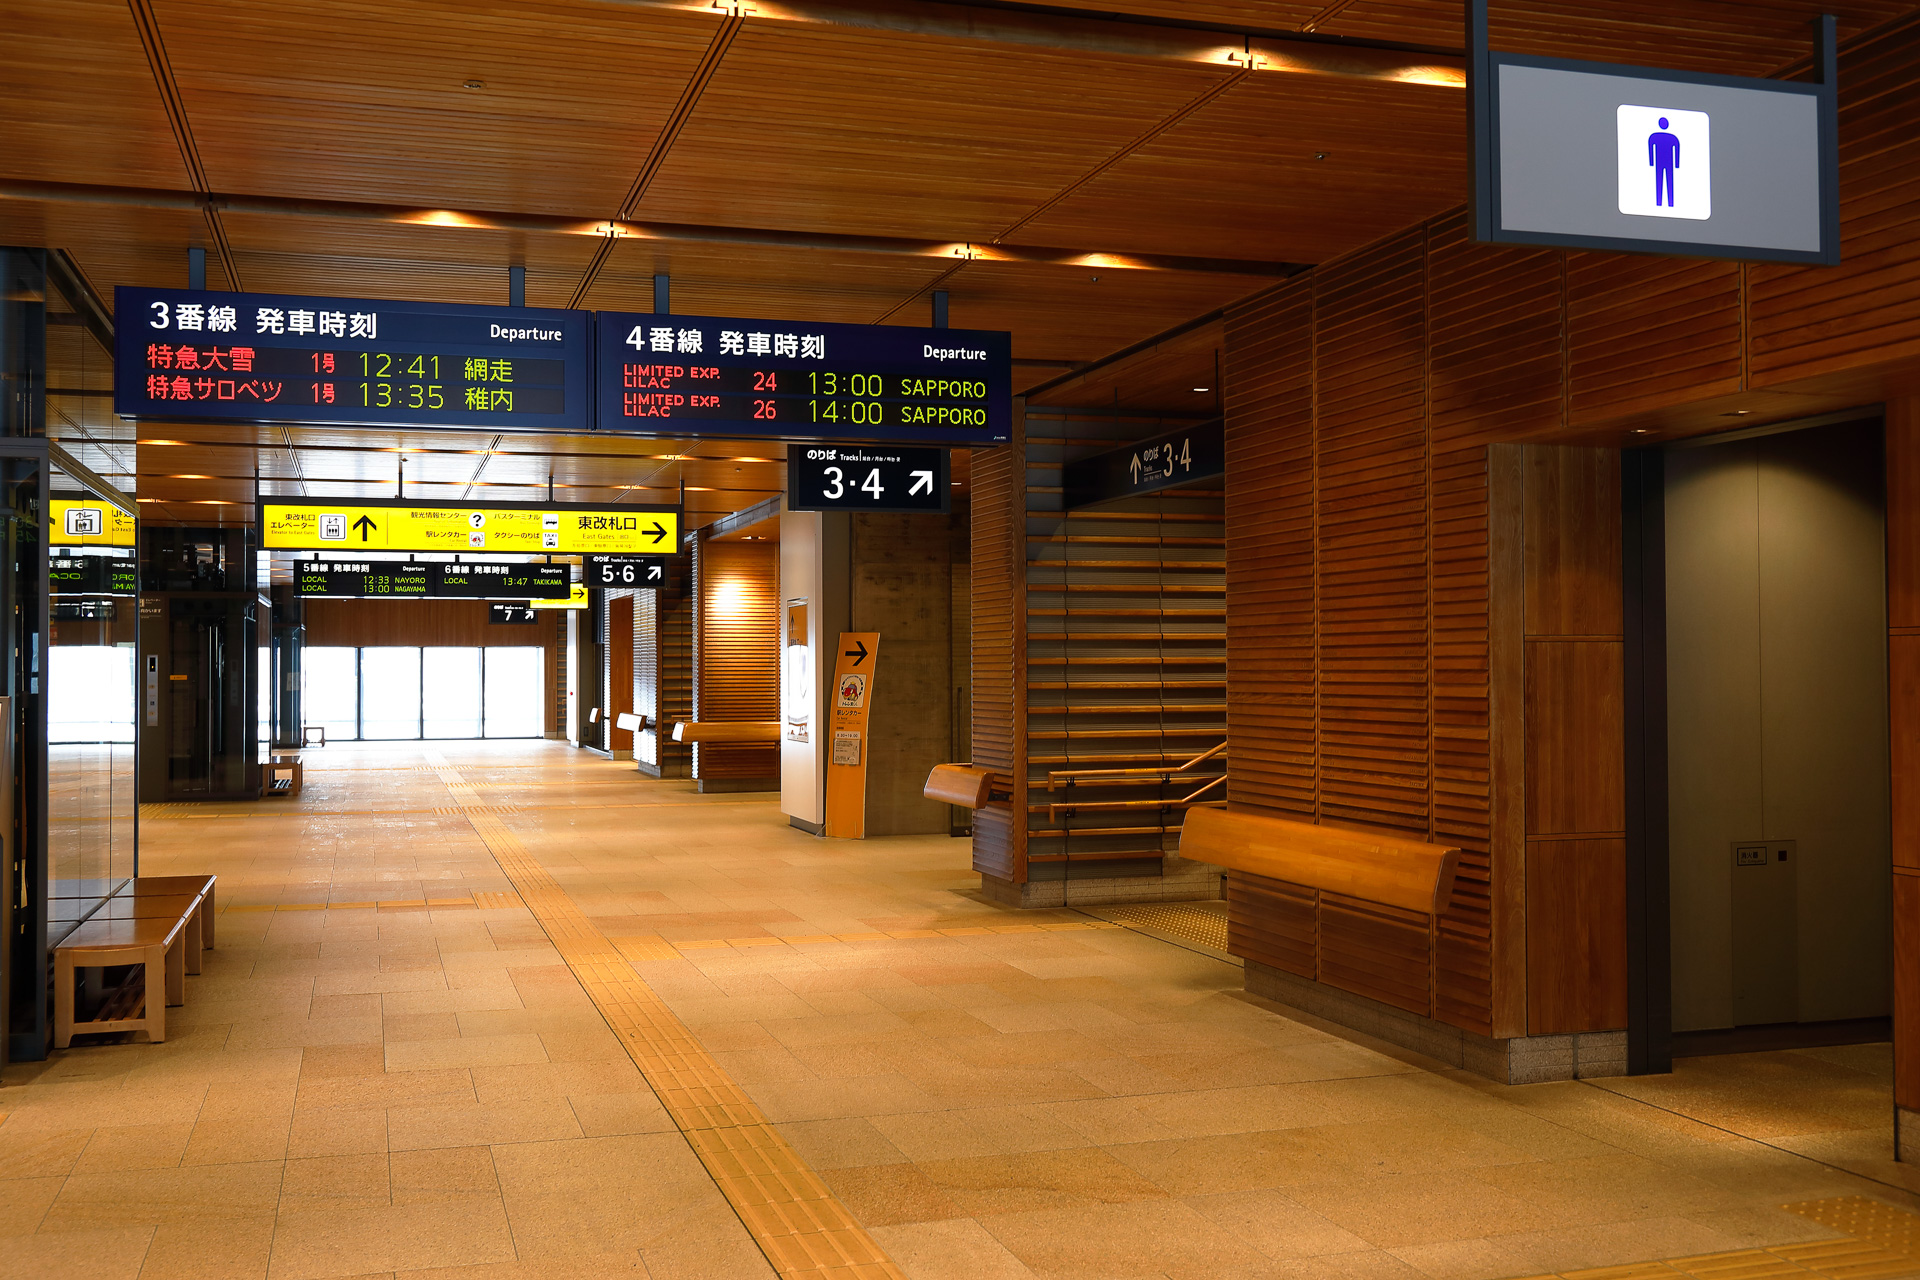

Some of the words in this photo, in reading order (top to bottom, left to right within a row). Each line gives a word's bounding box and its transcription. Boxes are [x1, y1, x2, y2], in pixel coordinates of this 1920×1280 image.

[150, 302, 237, 332] 3番線
[256, 308, 377, 339] 発車時刻
[490, 324, 562, 342] Departure
[626, 326, 703, 354] 4番線
[720, 330, 824, 360] 発車時刻
[924, 344, 986, 362] Departure
[148, 344, 255, 372] 特急大雪
[312, 352, 334, 374] 1号
[359, 353, 438, 379] 12:41
[464, 357, 513, 382] 網走
[624, 364, 684, 378] LIMITED
[690, 367, 720, 379] EXP.
[147, 374, 282, 402] 特急サロベツ
[312, 383, 334, 404] 1号
[360, 382, 444, 409] 13:35
[464, 387, 513, 412] 稚内
[624, 376, 670, 388] LILAC
[754, 372, 777, 392] 24
[808, 372, 882, 396] 13:00
[901, 379, 986, 398] SAPPORO
[624, 392, 684, 406] LIMITED
[690, 396, 720, 408] EXP.
[624, 405, 670, 418] LILAC
[754, 400, 776, 420] 26
[808, 400, 882, 424] 14:00
[901, 406, 986, 425] SAPPORO
[807, 450, 836, 461] のりば
[840, 453, 858, 462] Tracks
[578, 516, 636, 530] 東改札口
[303, 563, 328, 572] 5番線
[333, 564, 370, 573] 発車時刻
[445, 566, 470, 574] 6番線
[474, 566, 509, 575] 発車時刻
[364, 576, 390, 584] 12:33
[505, 610, 512, 621] 7
